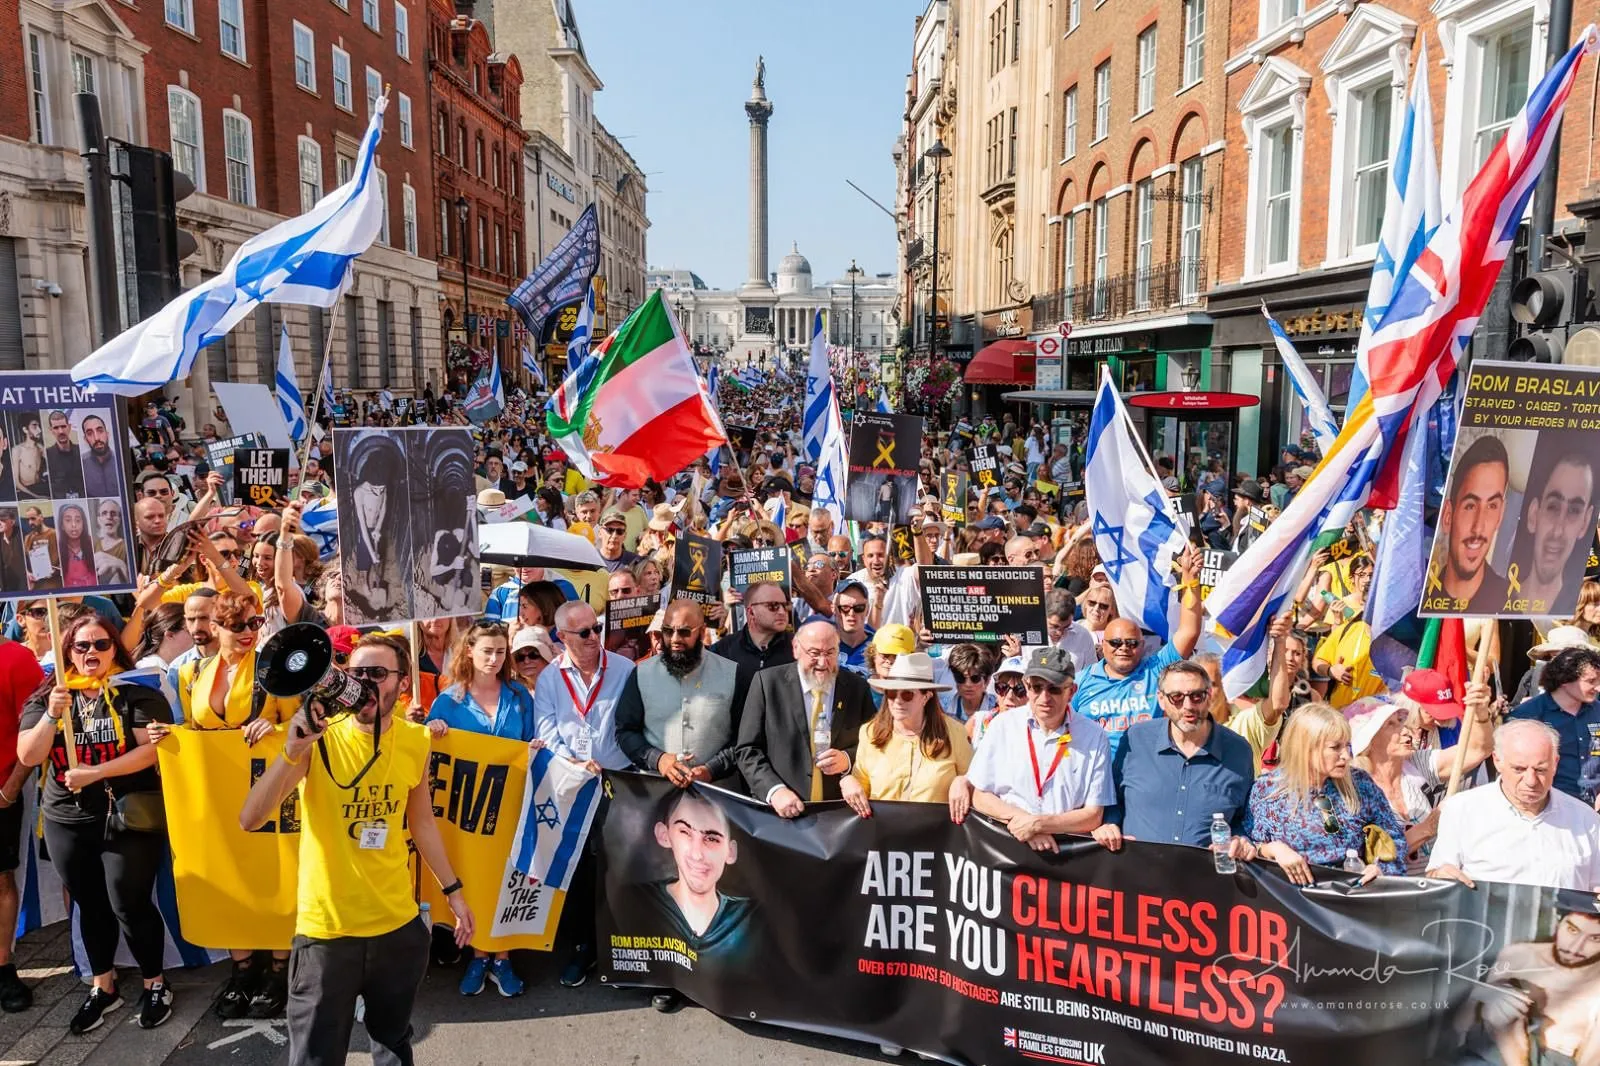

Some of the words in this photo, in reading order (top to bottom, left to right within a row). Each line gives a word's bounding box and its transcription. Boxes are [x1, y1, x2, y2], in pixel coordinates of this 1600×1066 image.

[1284, 307, 1322, 333] CAFÉ
[1326, 312, 1349, 330] DE
[1080, 338, 1093, 354] BOX
[1095, 337, 1123, 352] BRITAIN
[1470, 374, 1510, 392] ROM
[1515, 377, 1600, 397] BRASLAV
[2, 387, 29, 405] AT
[31, 386, 97, 405] THEM!
[1465, 397, 1515, 410] STARVED
[1526, 400, 1561, 412] CAGED
[1474, 413, 1489, 424] BY
[1494, 415, 1521, 425] YOUR
[1524, 416, 1564, 428] HEROES
[1567, 419, 1578, 429] IN
[1581, 419, 1600, 430] GAZ
[232, 437, 244, 446] ARE
[250, 450, 275, 468] LET
[974, 446, 988, 459] LET
[970, 457, 997, 473] THEM
[240, 468, 283, 485] THEM
[734, 551, 759, 563] HAMAS
[761, 549, 774, 561] ARE
[1204, 550, 1224, 569] LET
[734, 561, 769, 574] STARVING
[925, 571, 955, 580] THERE
[957, 571, 967, 579] IS
[968, 571, 983, 580] NO
[985, 571, 1036, 580] GENOCIDE
[735, 574, 747, 585] THE
[748, 570, 784, 584] HOSTAGES
[676, 589, 704, 603] RELEASE
[929, 595, 949, 604] 350
[950, 595, 981, 604] MILES
[982, 596, 992, 604] OF
[995, 596, 1040, 605] TUNNELS
[942, 587, 967, 595] THERE
[968, 587, 985, 596] ARE
[610, 598, 634, 610] HAMAS
[636, 596, 648, 606] ARE
[930, 604, 962, 613] UNDER
[963, 604, 1012, 614] SCHOOLS,
[1423, 599, 1450, 610] AGE
[1452, 599, 1469, 610] 19
[1503, 599, 1528, 611] AGE
[1531, 600, 1547, 611] 21
[609, 620, 622, 630] THE
[931, 613, 977, 622] MOSQUES
[978, 613, 999, 622] AND
[932, 621, 984, 631] HOSPITALS
[1089, 696, 1150, 716] SAHARA
[352, 784, 394, 803] LET
[342, 799, 400, 819] THEM
[511, 888, 541, 905] THE
[500, 904, 540, 924] HATE
[860, 850, 935, 899] ARE
[943, 851, 1002, 919] YOU
[1011, 873, 1218, 963] CLUELESS
[1229, 904, 1291, 969] OR
[610, 935, 632, 949] ROM
[633, 936, 687, 955] BRASLAVSKI
[612, 949, 652, 961] STARVED.
[653, 950, 693, 972] TORTURED.
[613, 959, 651, 973] BROKEN.
[863, 903, 937, 954] ARE
[946, 908, 1007, 976] YOU
[1016, 932, 1286, 1034] HEARTLESS?
[858, 958, 885, 976] OVER
[886, 962, 908, 977] 670
[909, 963, 938, 983] DAYS!
[939, 970, 952, 989] 50
[952, 976, 999, 1005] HOSTAGES
[1000, 992, 1023, 1009] ARE
[1023, 995, 1054, 1014] STILL
[1056, 999, 1090, 1020] BEING
[1091, 1005, 1142, 1032] STARVED
[1144, 1021, 1169, 1038] AND
[1171, 1026, 1234, 1054] TORTURED
[1236, 1041, 1251, 1057] IN
[1252, 1044, 1292, 1064] GAZA.
[1018, 1029, 1045, 1043] HOSTAGES
[1046, 1035, 1059, 1045] AND
[1059, 1037, 1082, 1049] MISSING
[1018, 1038, 1054, 1056] FAMILIES
[1054, 1046, 1082, 1061] FORUM
[1083, 1041, 1106, 1065] UK
